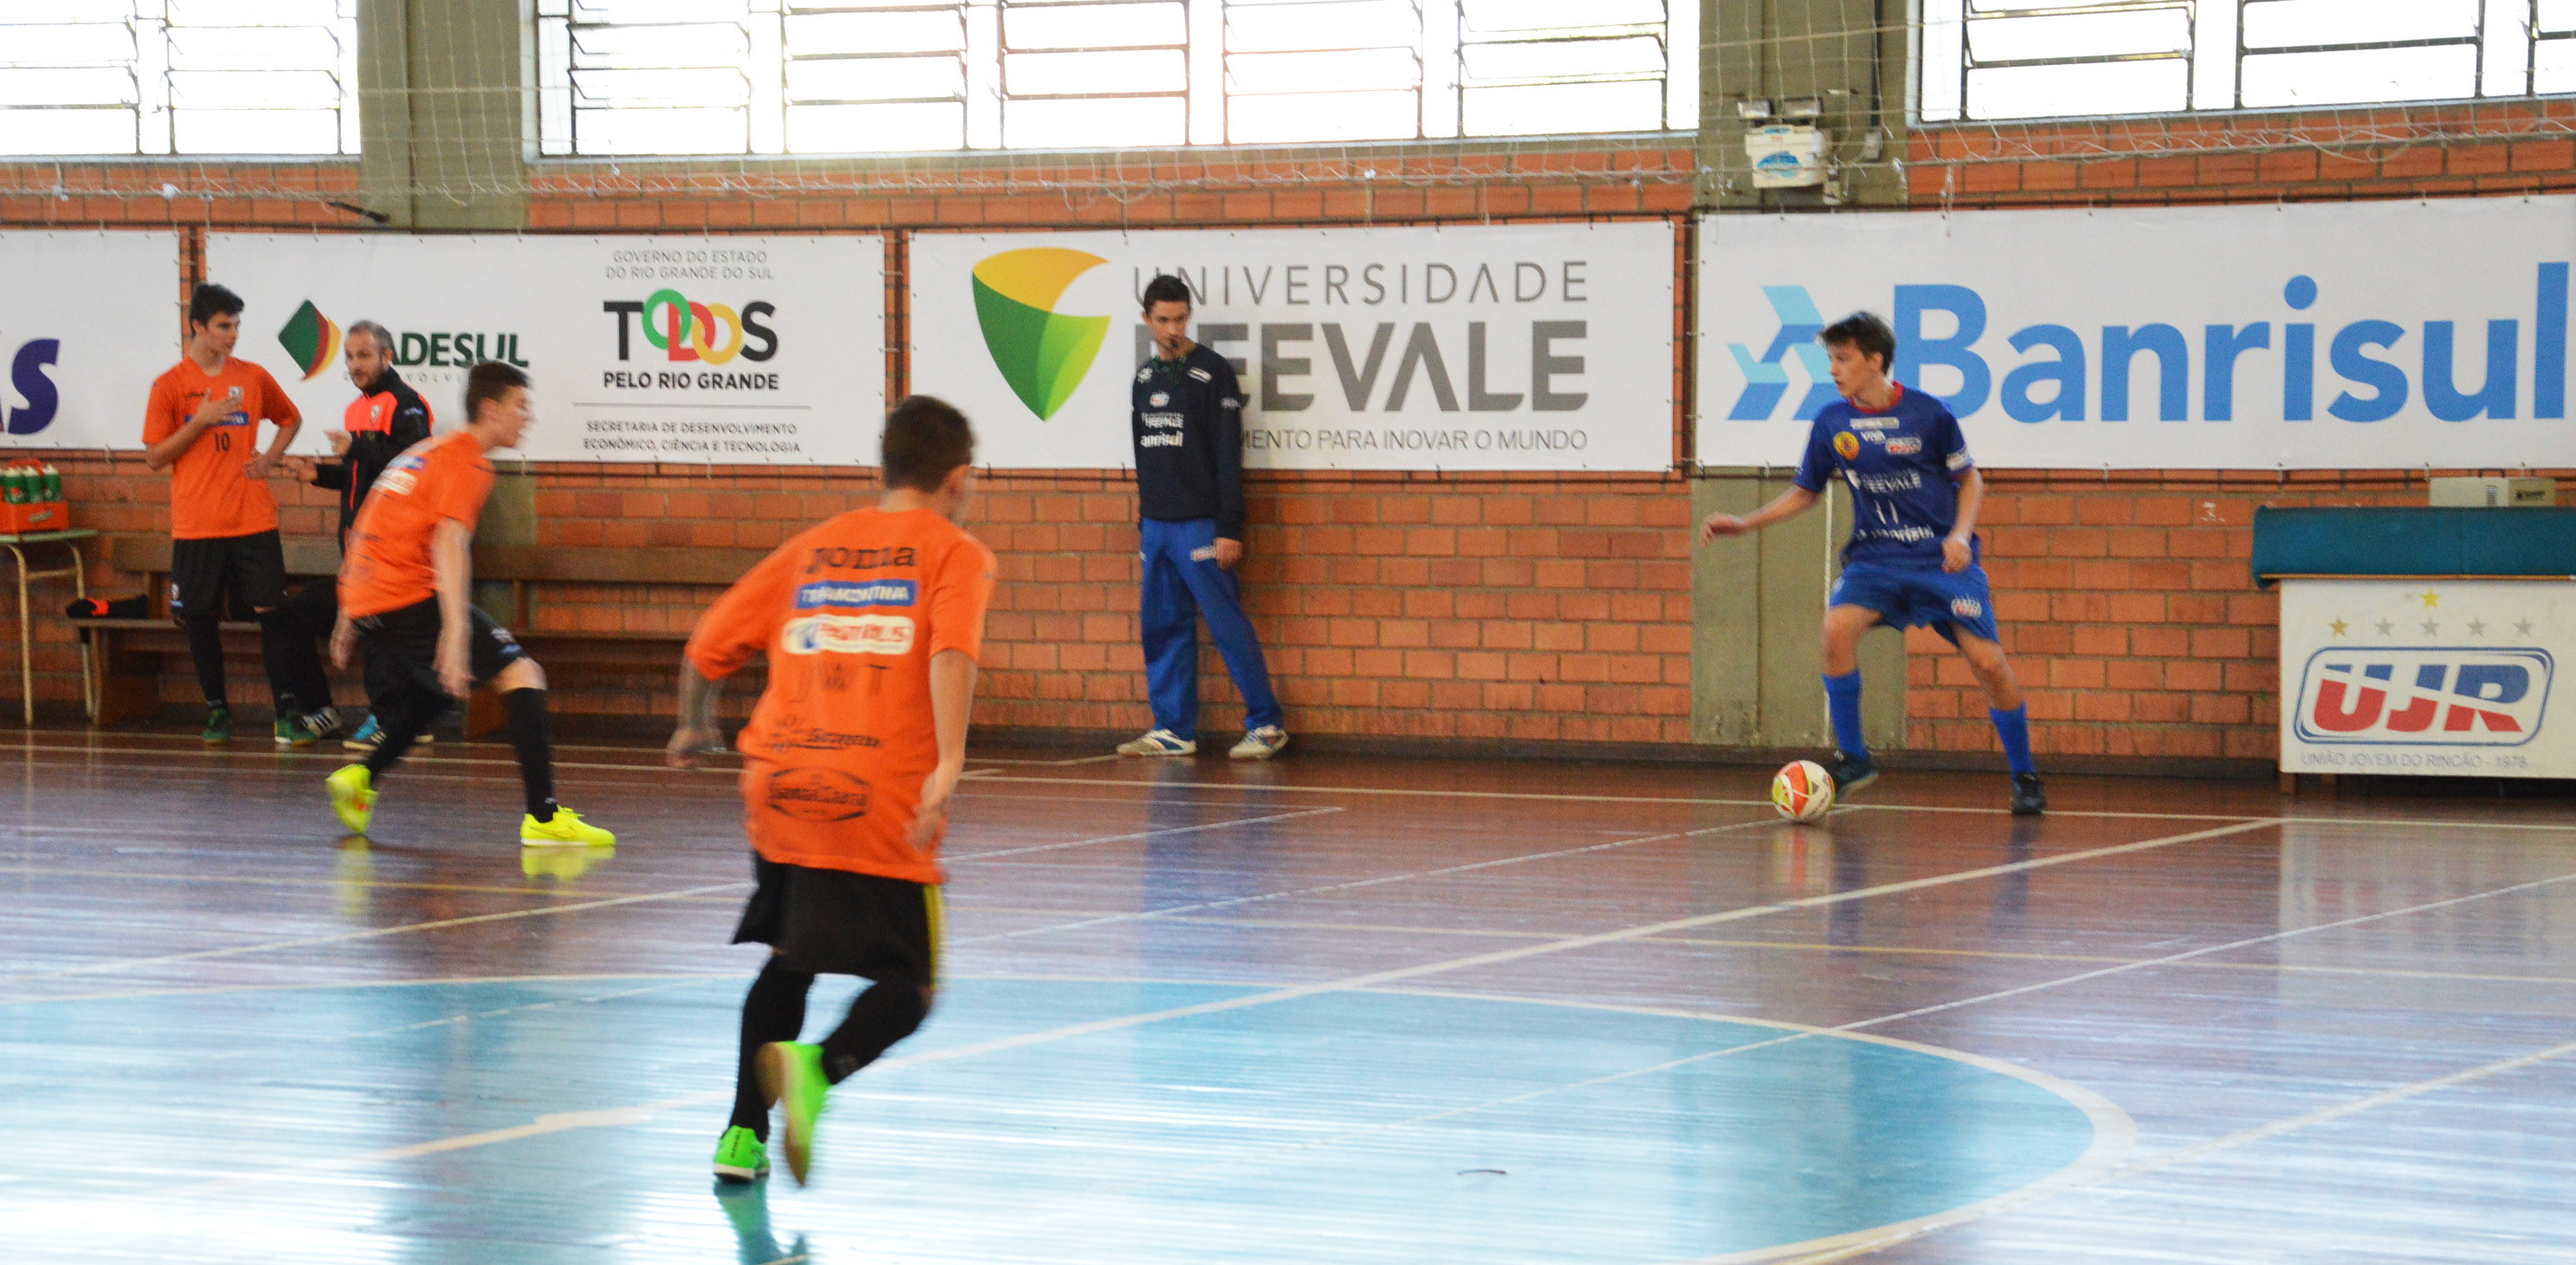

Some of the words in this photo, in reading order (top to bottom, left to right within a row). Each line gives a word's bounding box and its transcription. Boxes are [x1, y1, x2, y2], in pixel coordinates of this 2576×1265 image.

[613, 250, 682, 263] GOVERNO
[686, 250, 707, 263] DO
[712, 250, 768, 263] ESTADO
[605, 265, 627, 279] DO
[631, 265, 654, 279] RIO
[659, 265, 718, 279] GRANDE
[722, 265, 743, 279] DO
[748, 265, 775, 280] SUL
[603, 289, 779, 366] TODOS
[1893, 262, 2569, 425] Banrisul
[1135, 321, 1588, 412] EEVALE
[603, 372, 652, 389] PELO
[659, 373, 691, 389] RIO
[698, 373, 780, 391] GRANDE
[586, 420, 659, 433] SECRETARIA
[661, 421, 677, 433] DE
[681, 421, 797, 435] DESENVOLVIMENTO
[215, 431, 231, 451] 10
[661, 437, 709, 451] CIÊNCIA
[712, 440, 720, 451] E
[724, 440, 801, 453] TECNOLOGIA
[1317, 429, 1377, 450] PARA
[1383, 430, 1469, 450] INOVAR
[1474, 430, 1492, 450] O
[1498, 430, 1588, 450] MUNDO
[2313, 664, 2529, 732] UJR
[2300, 752, 2346, 766] UNIÃO
[2350, 753, 2398, 767] JOVEM
[2401, 754, 2423, 768] DO
